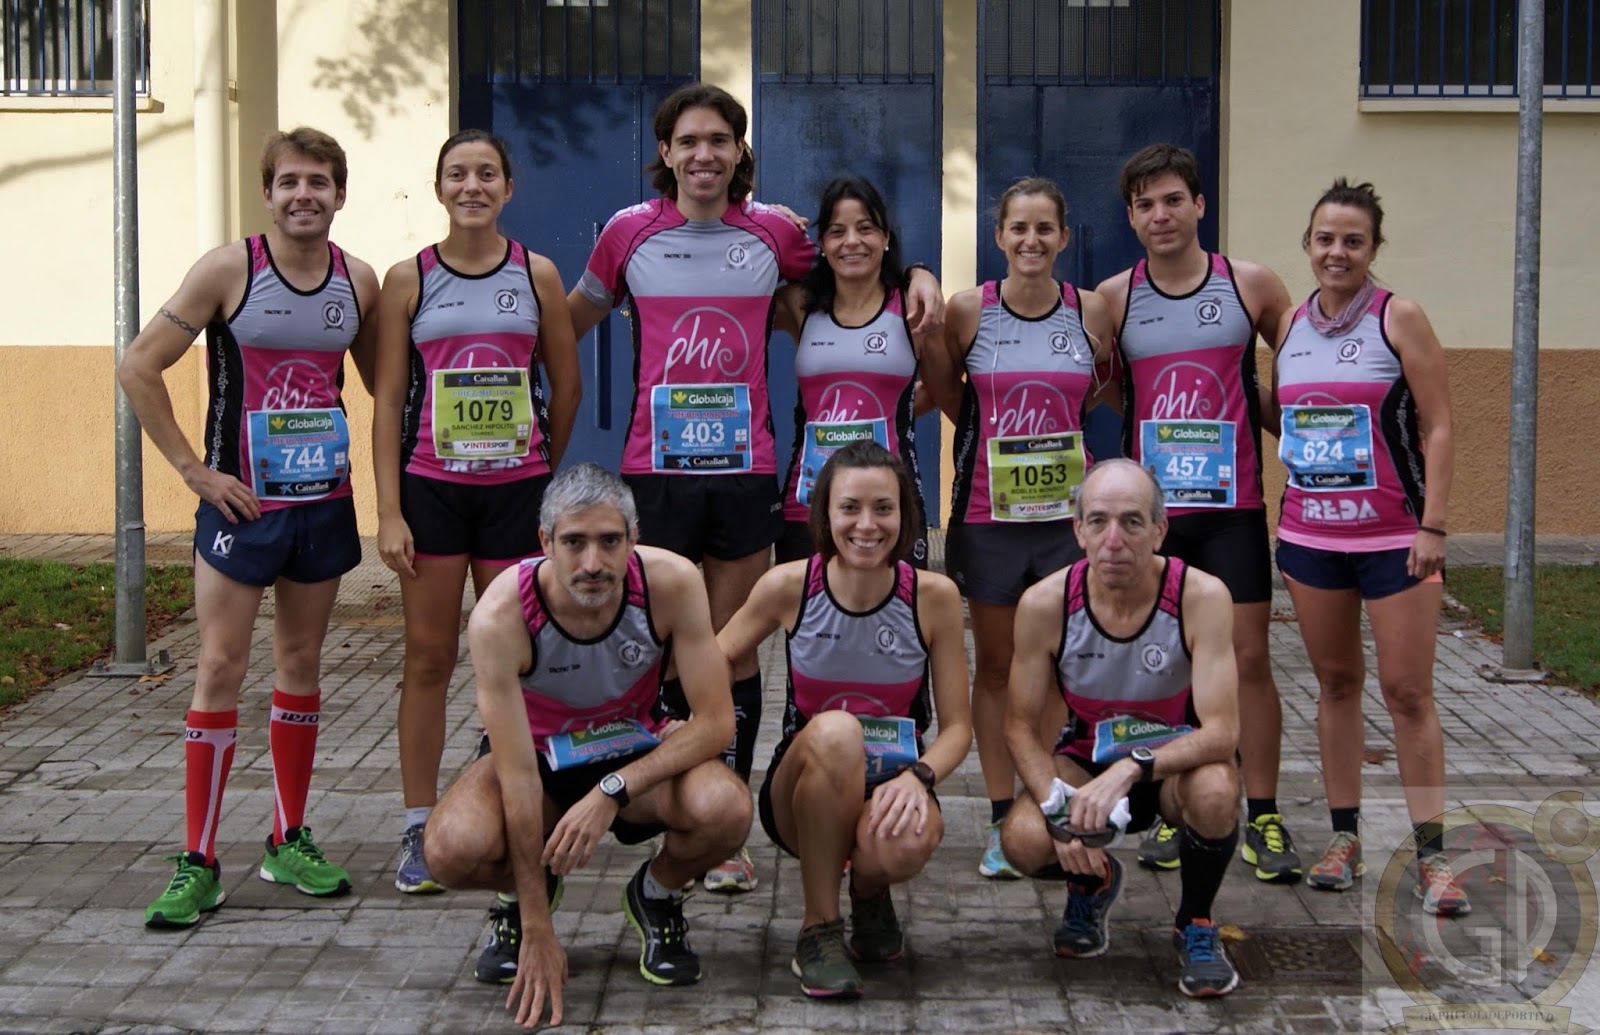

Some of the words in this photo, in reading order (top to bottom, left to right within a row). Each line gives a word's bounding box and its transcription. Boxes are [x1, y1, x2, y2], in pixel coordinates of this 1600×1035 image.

[663, 315, 727, 386] phi
[474, 374, 508, 382] CaixaBank
[688, 394, 733, 406] Globalcaja
[454, 400, 513, 422] 1079
[287, 417, 332, 429] Globalcaja
[1310, 414, 1354, 425] Globalcaja
[681, 422, 724, 443] 403
[1173, 429, 1219, 441] Globalcaja
[1028, 440, 1062, 448] CaixaBank
[1303, 441, 1344, 461] 624
[281, 446, 325, 469] 744
[693, 457, 729, 466] CaixaBank
[1166, 456, 1208, 476] 457
[1010, 464, 1066, 486] 1053
[295, 482, 329, 492] CaixaBank
[1177, 490, 1212, 499] CaixaBank
[1027, 503, 1062, 511] INTERSPORT
